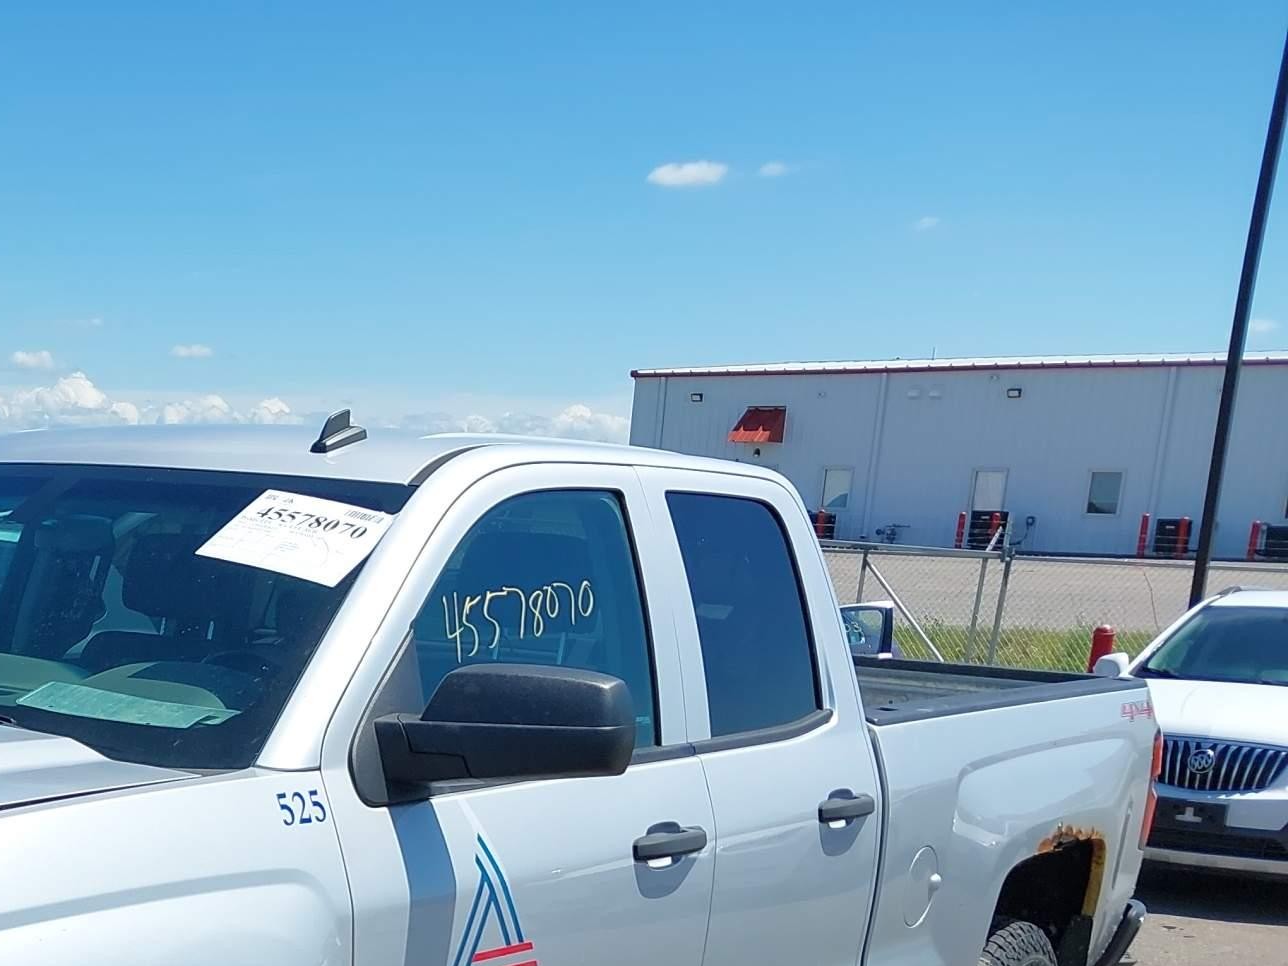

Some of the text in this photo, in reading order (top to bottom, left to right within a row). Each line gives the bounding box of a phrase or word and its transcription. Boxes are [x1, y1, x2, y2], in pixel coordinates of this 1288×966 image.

[257, 506, 368, 540] 45578070
[442, 580, 595, 664] 45578070
[276, 789, 327, 826] 525
